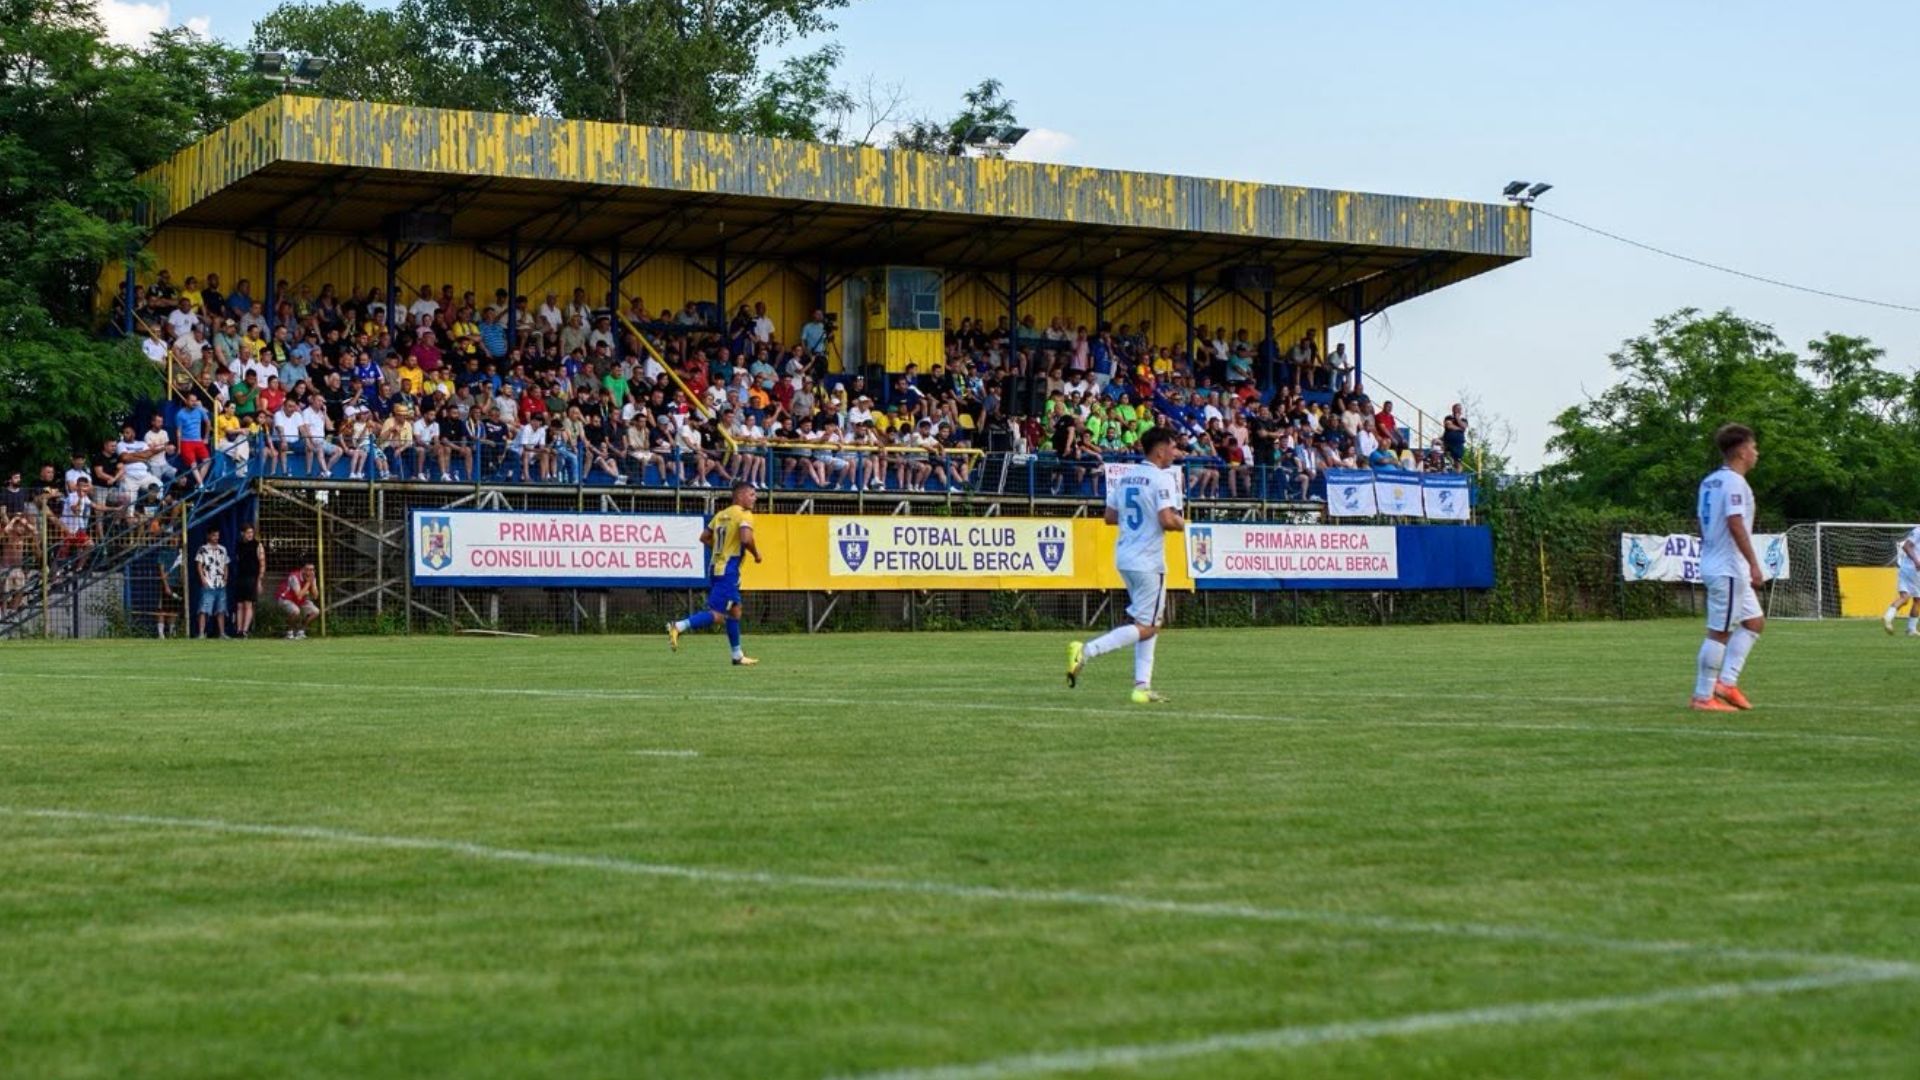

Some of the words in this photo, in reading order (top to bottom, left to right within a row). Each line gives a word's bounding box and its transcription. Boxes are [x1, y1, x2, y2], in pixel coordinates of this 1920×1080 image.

[1125, 487, 1143, 531] 5
[499, 519, 594, 543] PRIMĂRIA
[600, 524, 666, 544] BERCA
[894, 526, 963, 546] FOTBAL
[968, 527, 1016, 547] CLUB
[1245, 528, 1316, 549] PRIMĂRIA
[1320, 533, 1369, 550] BERCA
[471, 549, 566, 568] CONSILIUL
[571, 551, 630, 569] LOCAL
[636, 551, 693, 569] BERCA
[874, 551, 967, 570] PETROLUL
[973, 552, 1034, 571] BERCA
[1225, 555, 1297, 571] CONSILIUL
[1299, 556, 1342, 572] LOCAL
[1346, 556, 1389, 572] BERCA
